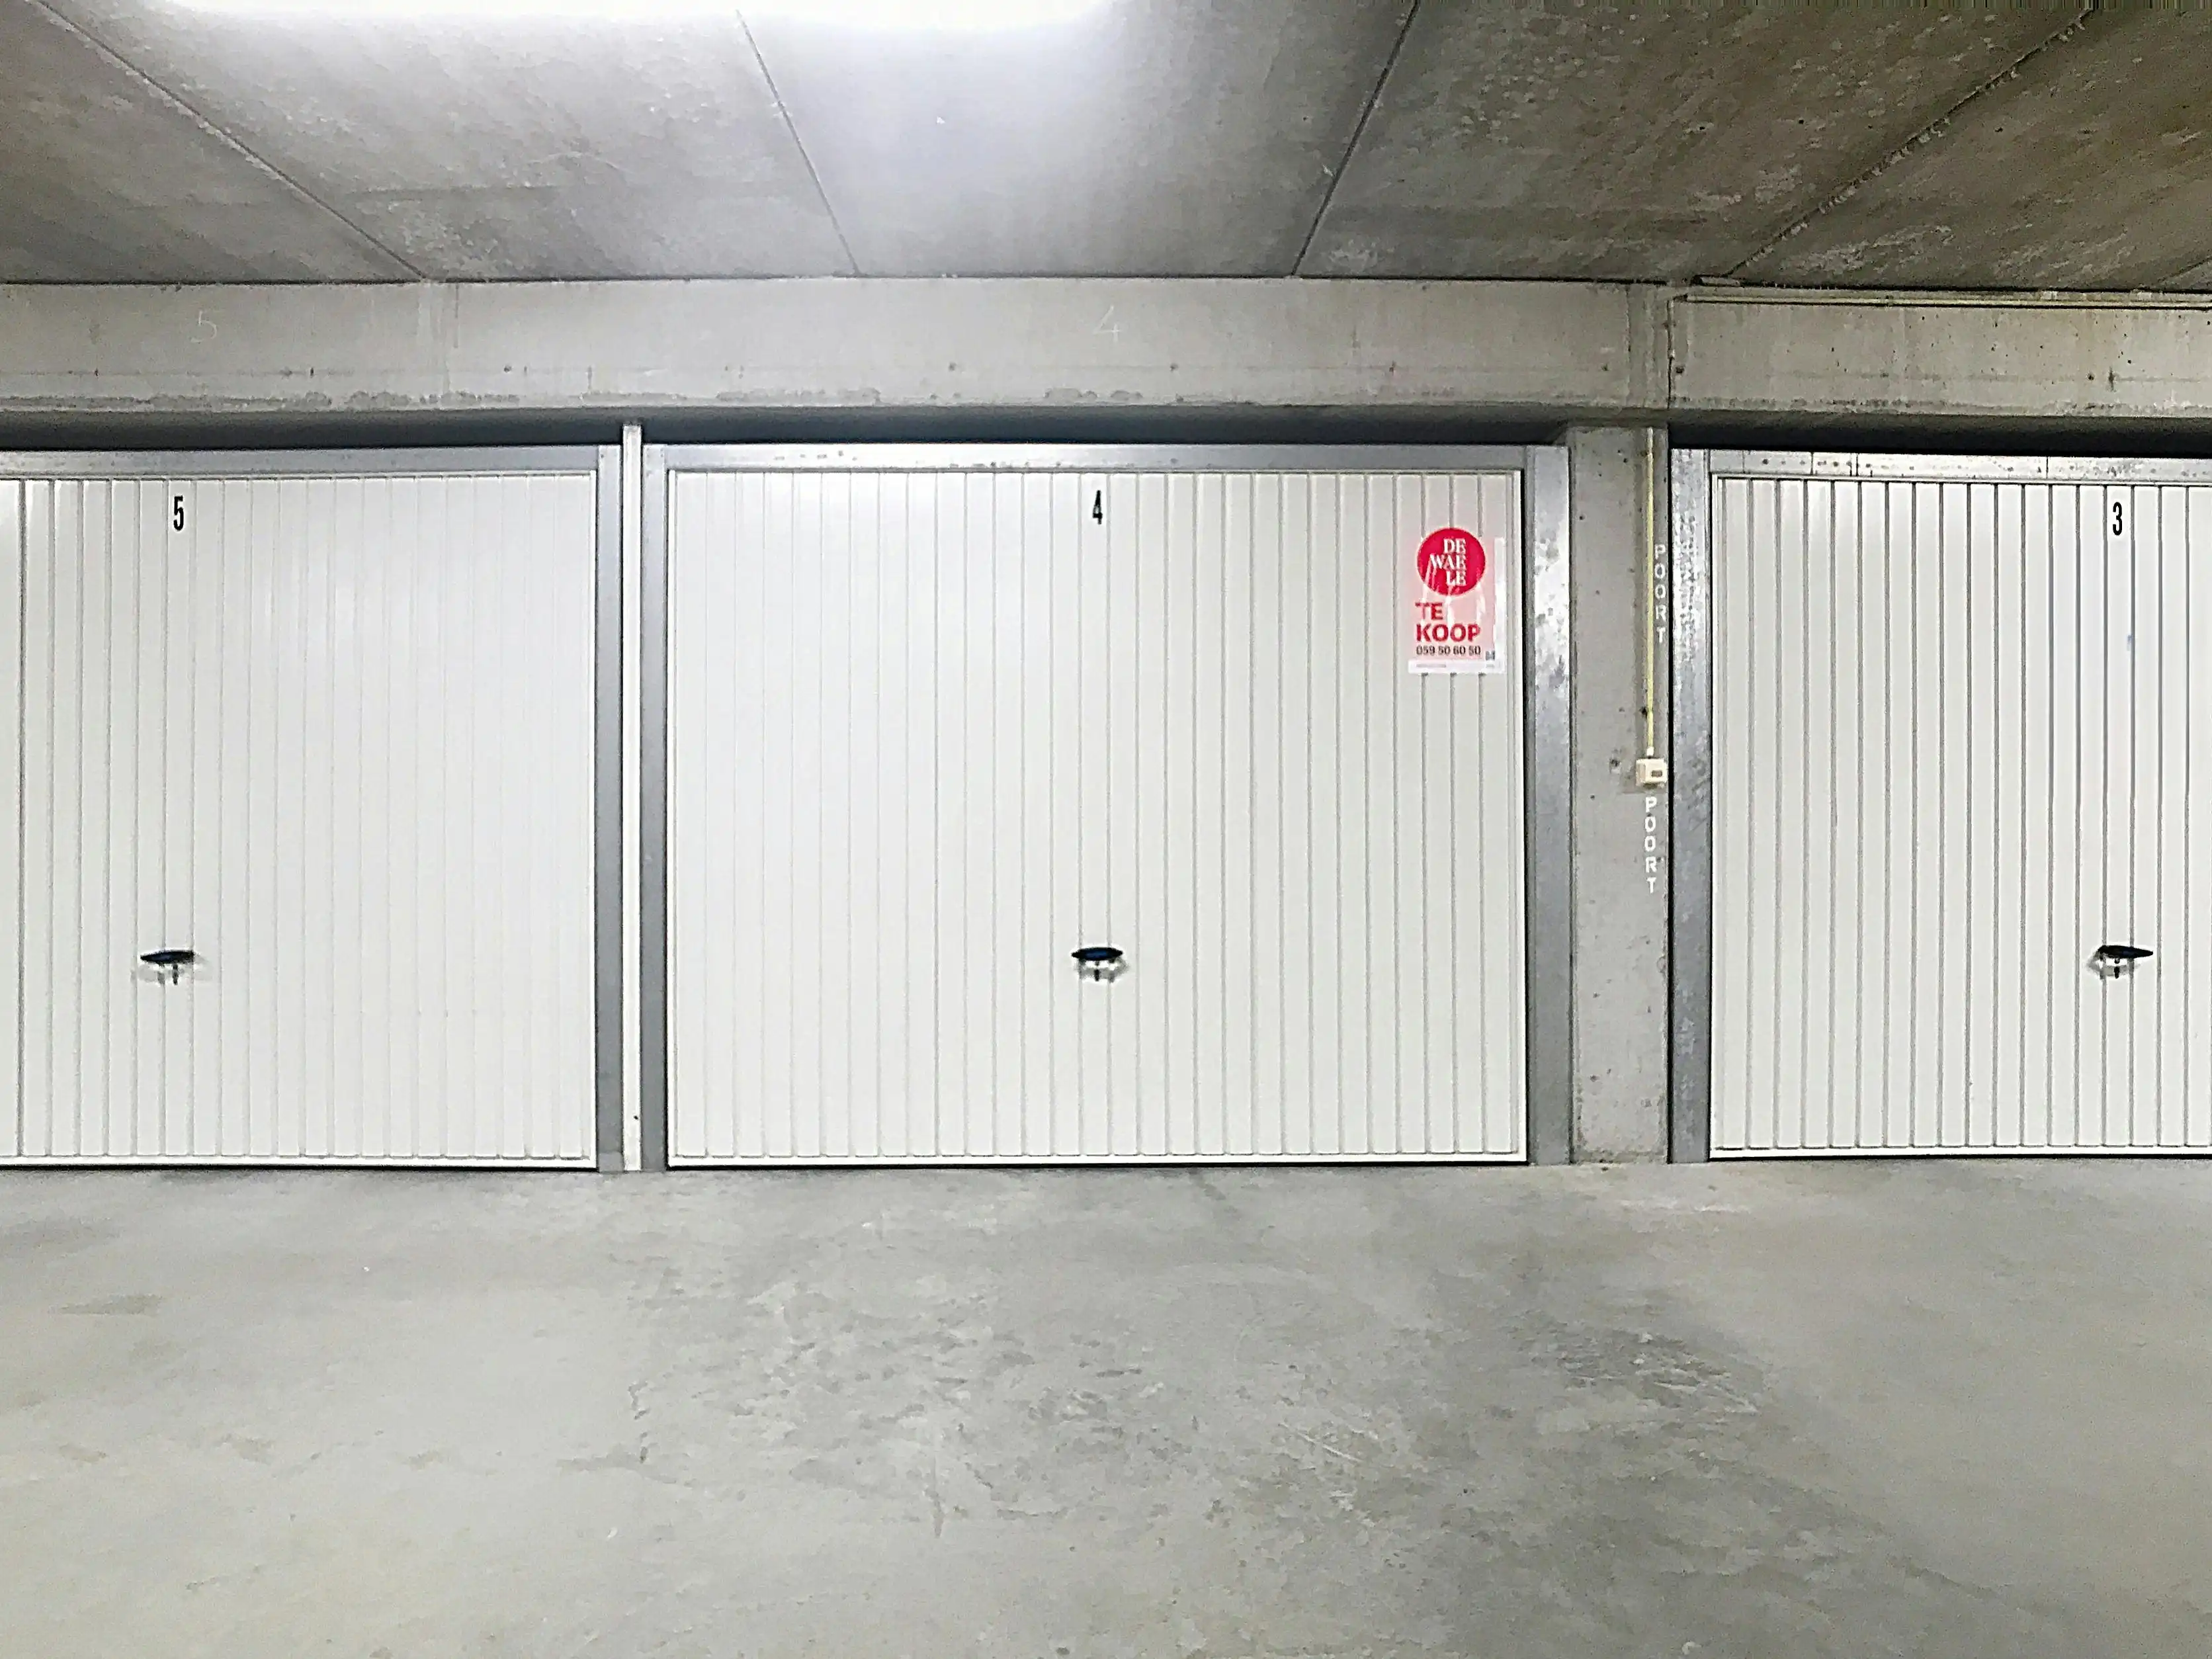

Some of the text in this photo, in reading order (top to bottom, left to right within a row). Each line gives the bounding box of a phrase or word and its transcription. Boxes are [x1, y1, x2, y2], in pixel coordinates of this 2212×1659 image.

[173, 495, 185, 531] 5
[1092, 489, 1103, 525] 4
[2111, 501, 2123, 536] 3
[1443, 538, 1467, 554] DE
[1445, 570, 1467, 586] LE
[1654, 543, 1667, 644] POORT
[1415, 601, 1444, 620] TE
[1416, 623, 1481, 642] KOOP
[1416, 645, 1435, 656] 059
[1644, 796, 1658, 894] POORT
